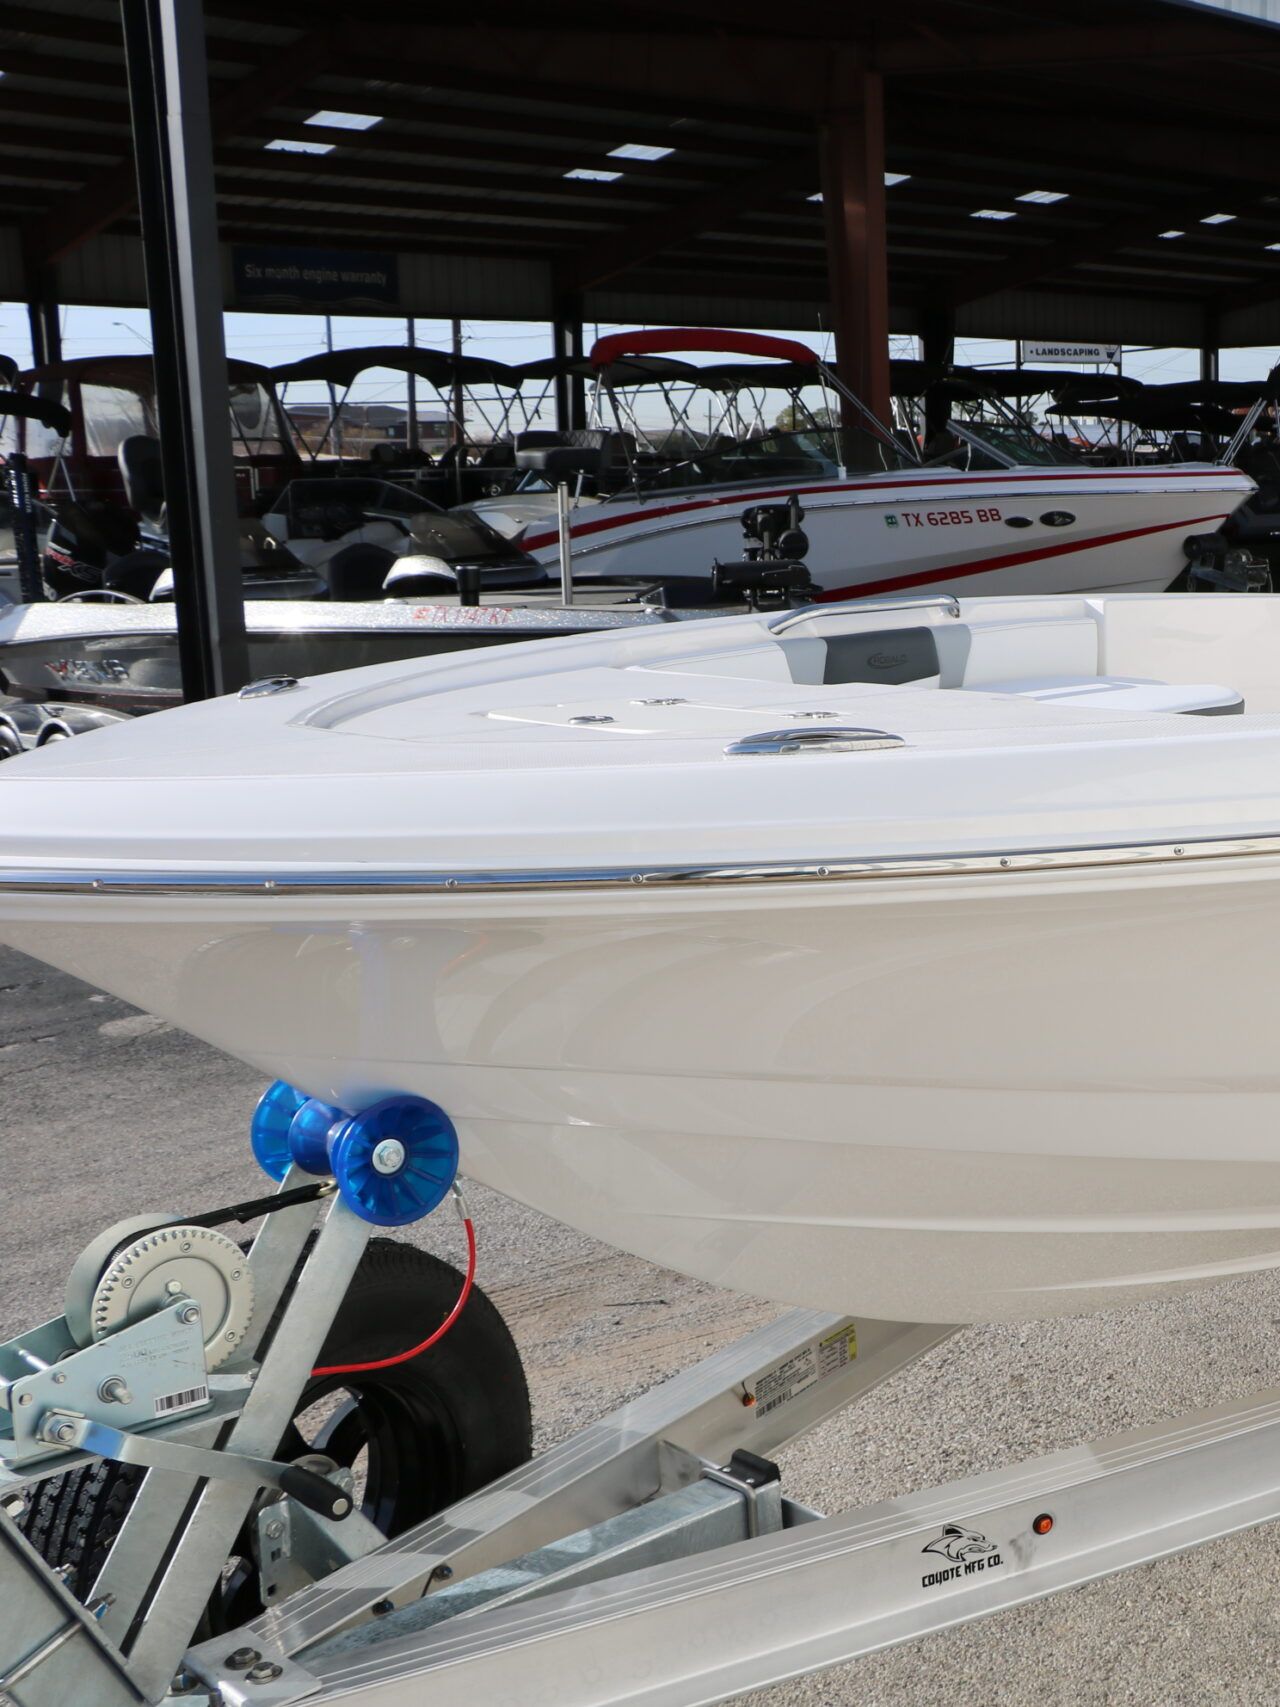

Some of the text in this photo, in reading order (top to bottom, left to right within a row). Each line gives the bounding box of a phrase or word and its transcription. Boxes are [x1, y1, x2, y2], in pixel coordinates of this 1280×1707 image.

[244, 264, 387, 287] Six month engine warranty
[1035, 347, 1100, 357] LANDSCAPING
[902, 512, 924, 528] TX
[926, 510, 974, 527] 6285
[976, 507, 1002, 523] BB
[921, 1553, 1004, 1588] COYOTE MFG CO.
